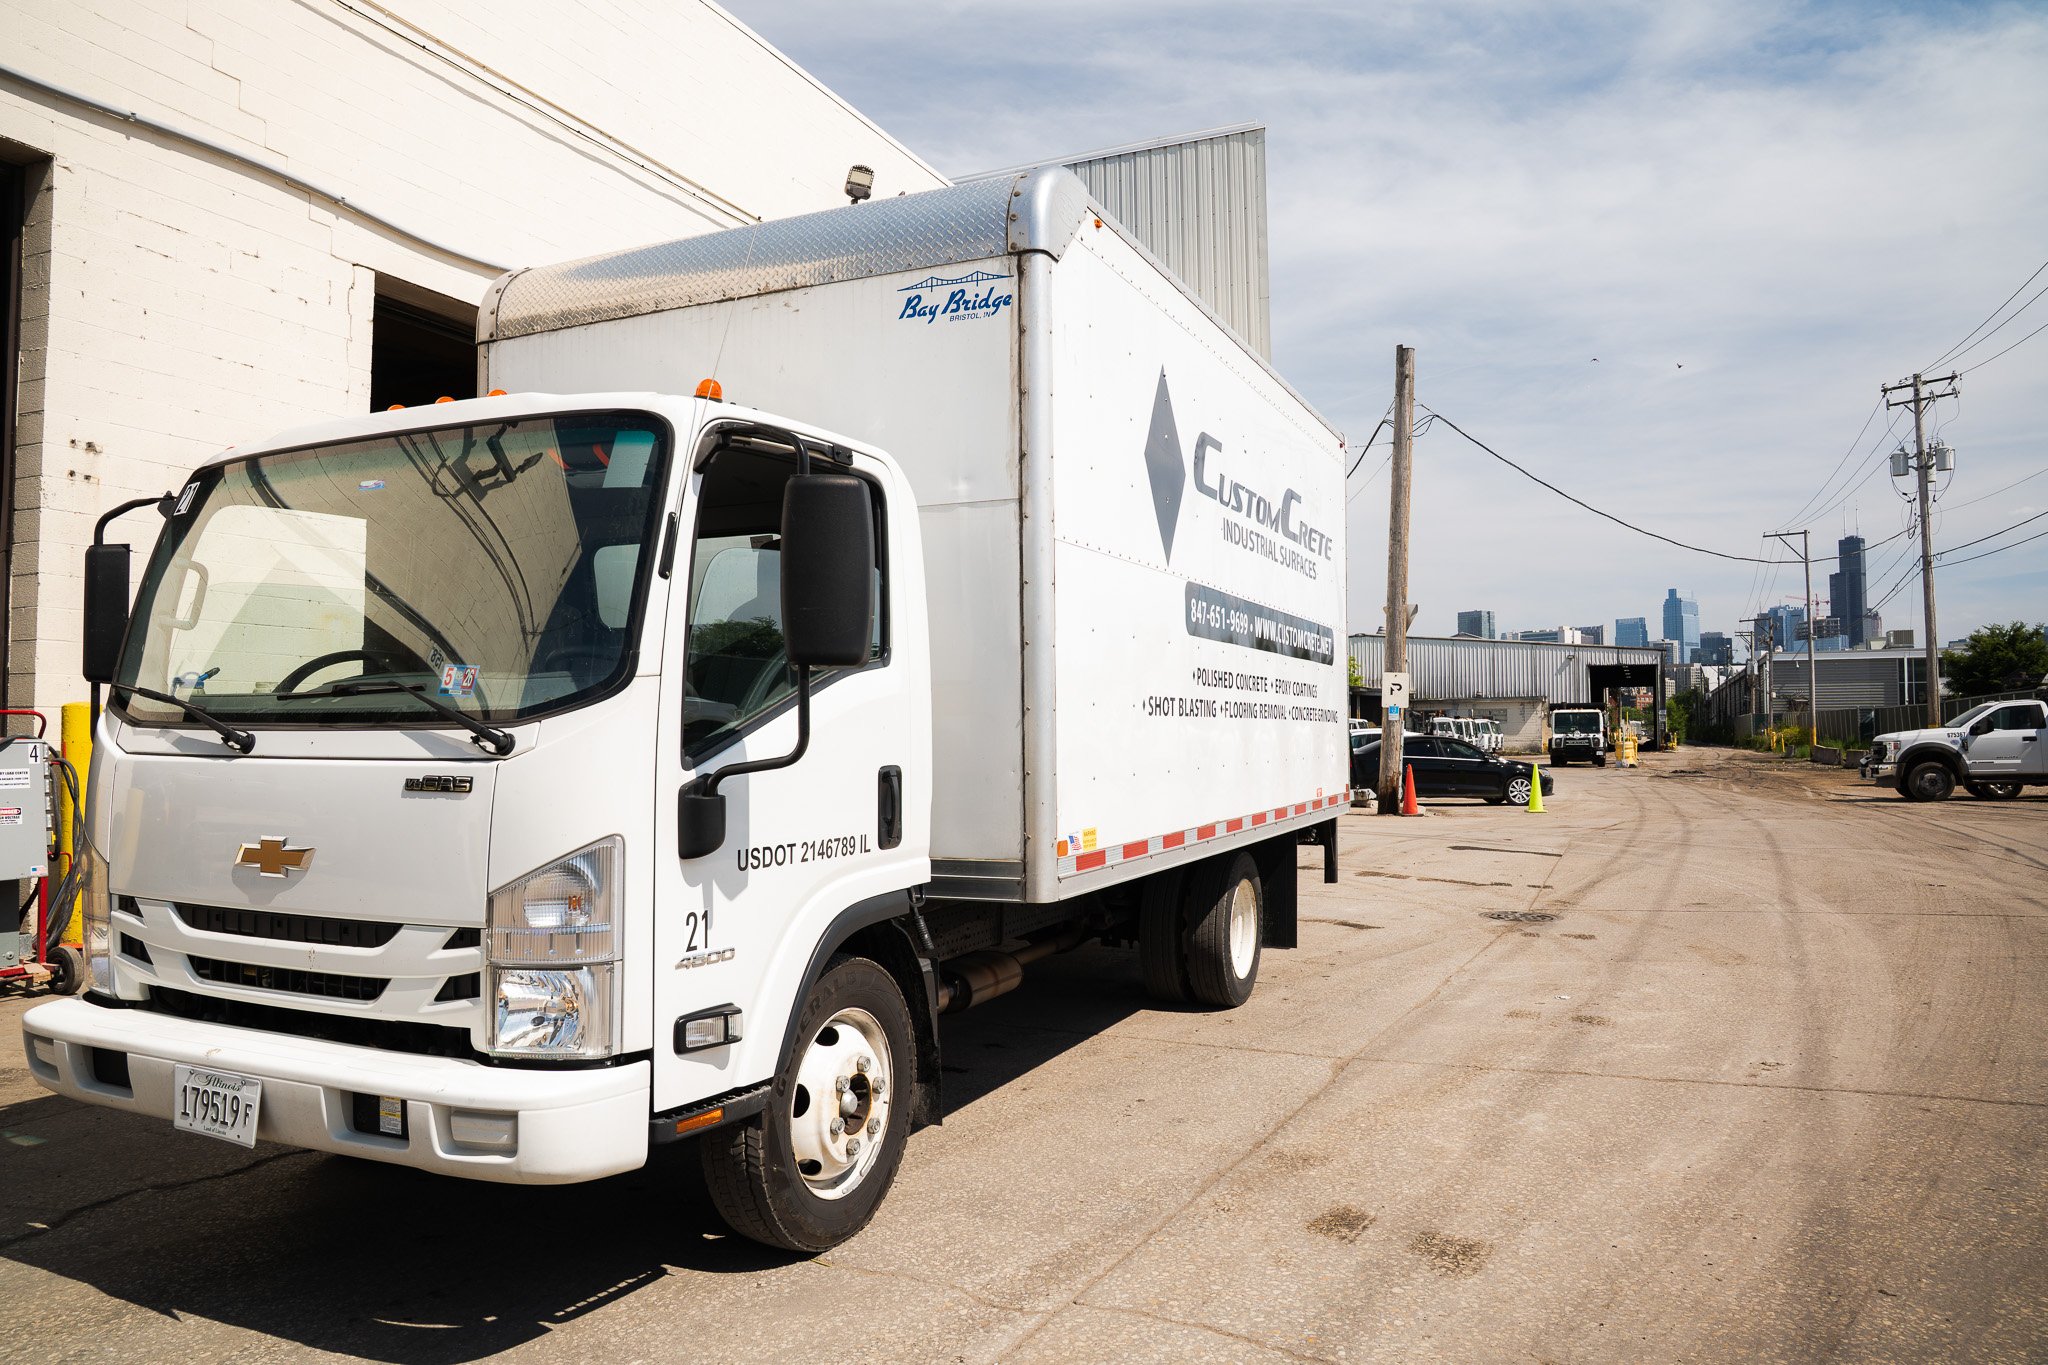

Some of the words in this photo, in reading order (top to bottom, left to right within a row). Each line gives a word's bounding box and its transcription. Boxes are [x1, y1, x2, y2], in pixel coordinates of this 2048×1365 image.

[898, 294, 940, 324] Bay
[941, 286, 1013, 316] Bridge
[949, 312, 981, 322] BRISTOL,
[175, 484, 199, 514] 21
[1223, 517, 1279, 563] INDUSTRIAL
[1279, 545, 1318, 580] SURFACES
[1190, 598, 1249, 635] 847-651-9699
[444, 667, 455, 686] 5
[462, 668, 475, 687] 26
[1196, 667, 1234, 690] POLISHED
[1235, 673, 1268, 693] CONCRETE
[1275, 678, 1291, 696] EPOXY
[1292, 681, 1318, 699] COATINGS
[1148, 695, 1176, 717] SHOT
[1178, 698, 1217, 718] BLASTING
[1224, 700, 1258, 719] FLOORING
[1260, 703, 1287, 720] REMOVAL
[1291, 706, 1317, 722] CONCRETE
[29, 744, 39, 763] 4
[422, 775, 474, 793] GAS
[737, 842, 797, 872] USDOT
[800, 836, 856, 863] 2146789
[860, 834, 871, 854] IL
[685, 909, 709, 953] 21
[674, 947, 736, 970] 4500
[193, 1073, 241, 1092] Illinois
